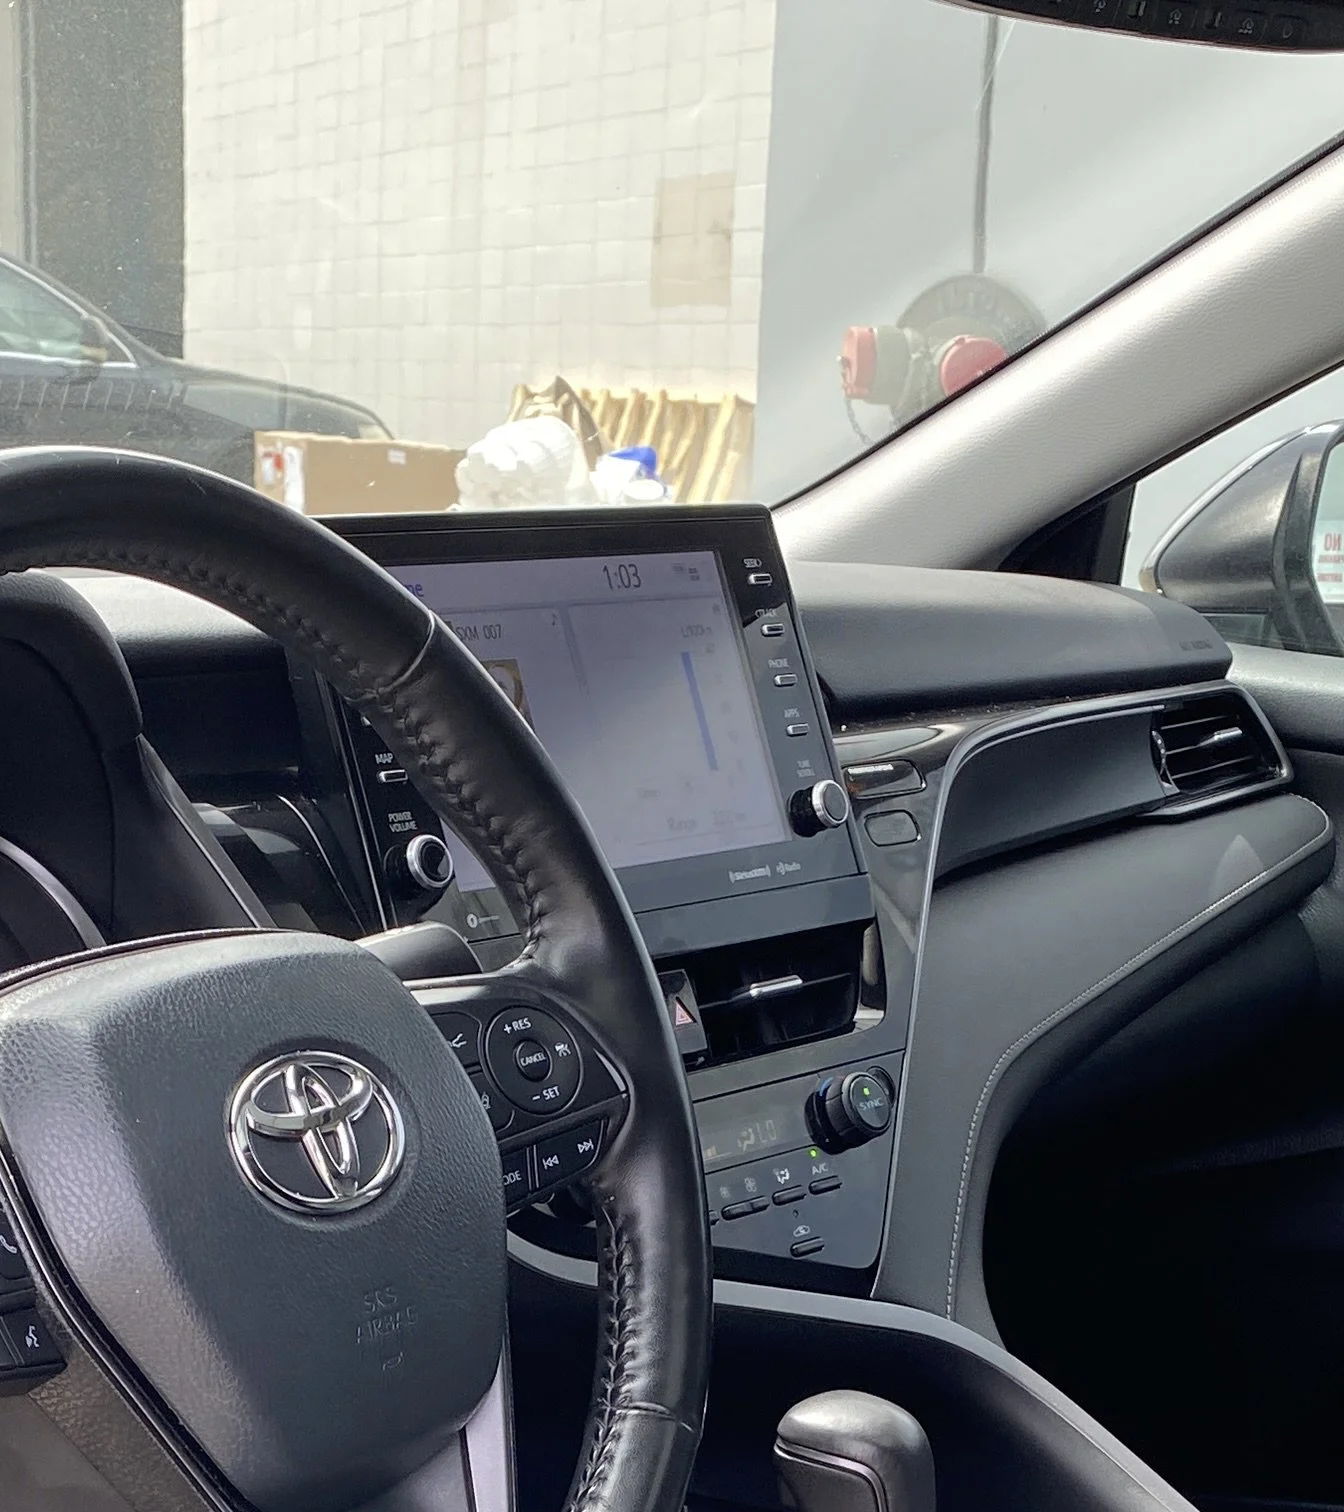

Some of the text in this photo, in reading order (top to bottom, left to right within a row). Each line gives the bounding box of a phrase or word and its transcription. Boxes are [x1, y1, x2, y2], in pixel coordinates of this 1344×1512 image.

[602, 563, 642, 591] 1:03
[375, 753, 393, 764] MAP
[388, 811, 413, 822] POWER
[389, 820, 418, 833] VOLUME
[520, 1051, 546, 1067] CANCEL
[811, 1162, 829, 1176] A/C
[502, 1169, 523, 1186] ODE
